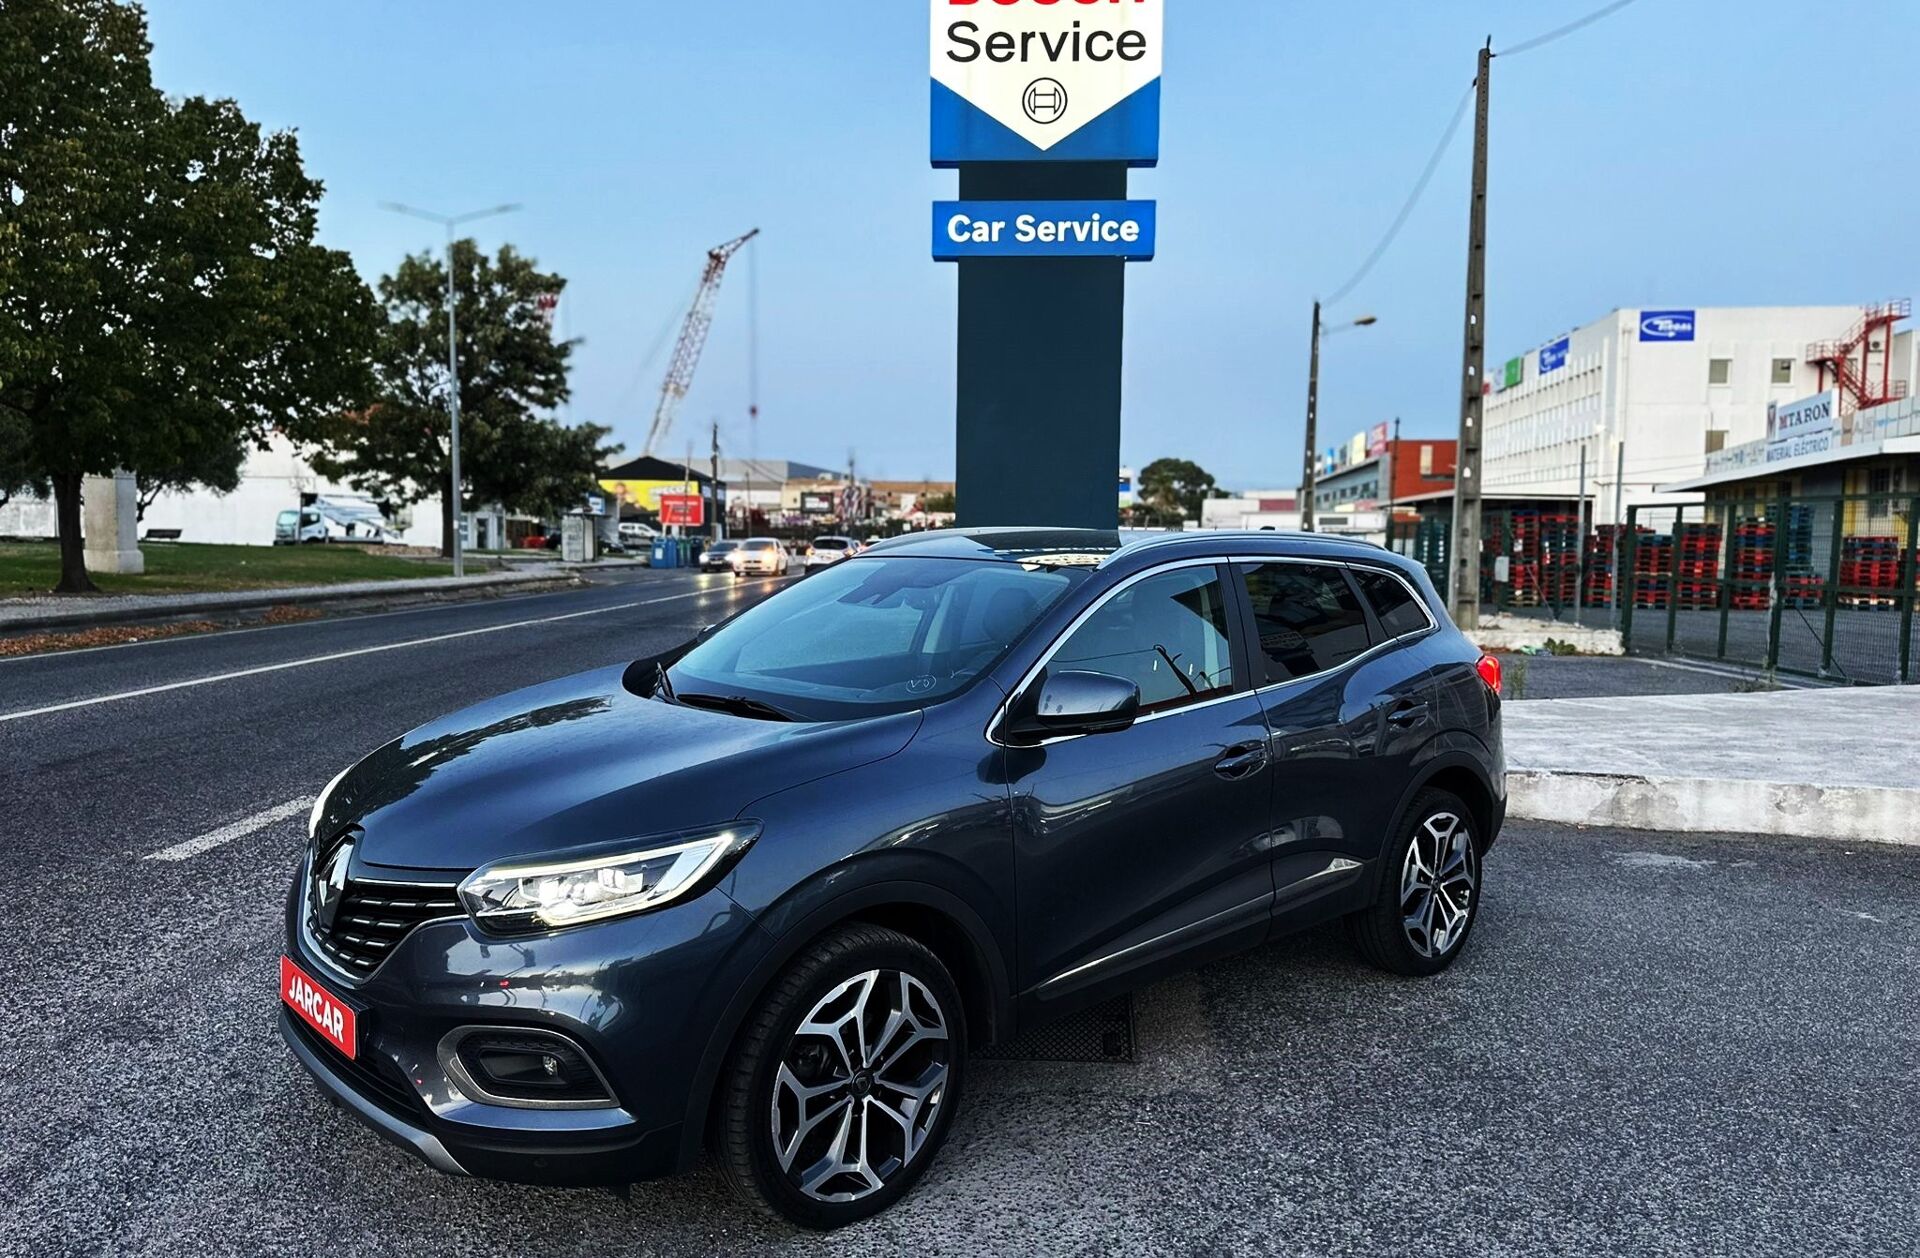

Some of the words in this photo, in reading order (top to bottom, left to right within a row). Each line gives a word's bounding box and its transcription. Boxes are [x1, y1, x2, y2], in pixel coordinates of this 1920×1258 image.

[946, 20, 1146, 62] Service
[947, 214, 1005, 242] Car
[1014, 213, 1140, 243] Service
[288, 975, 344, 1044] JARCAR
